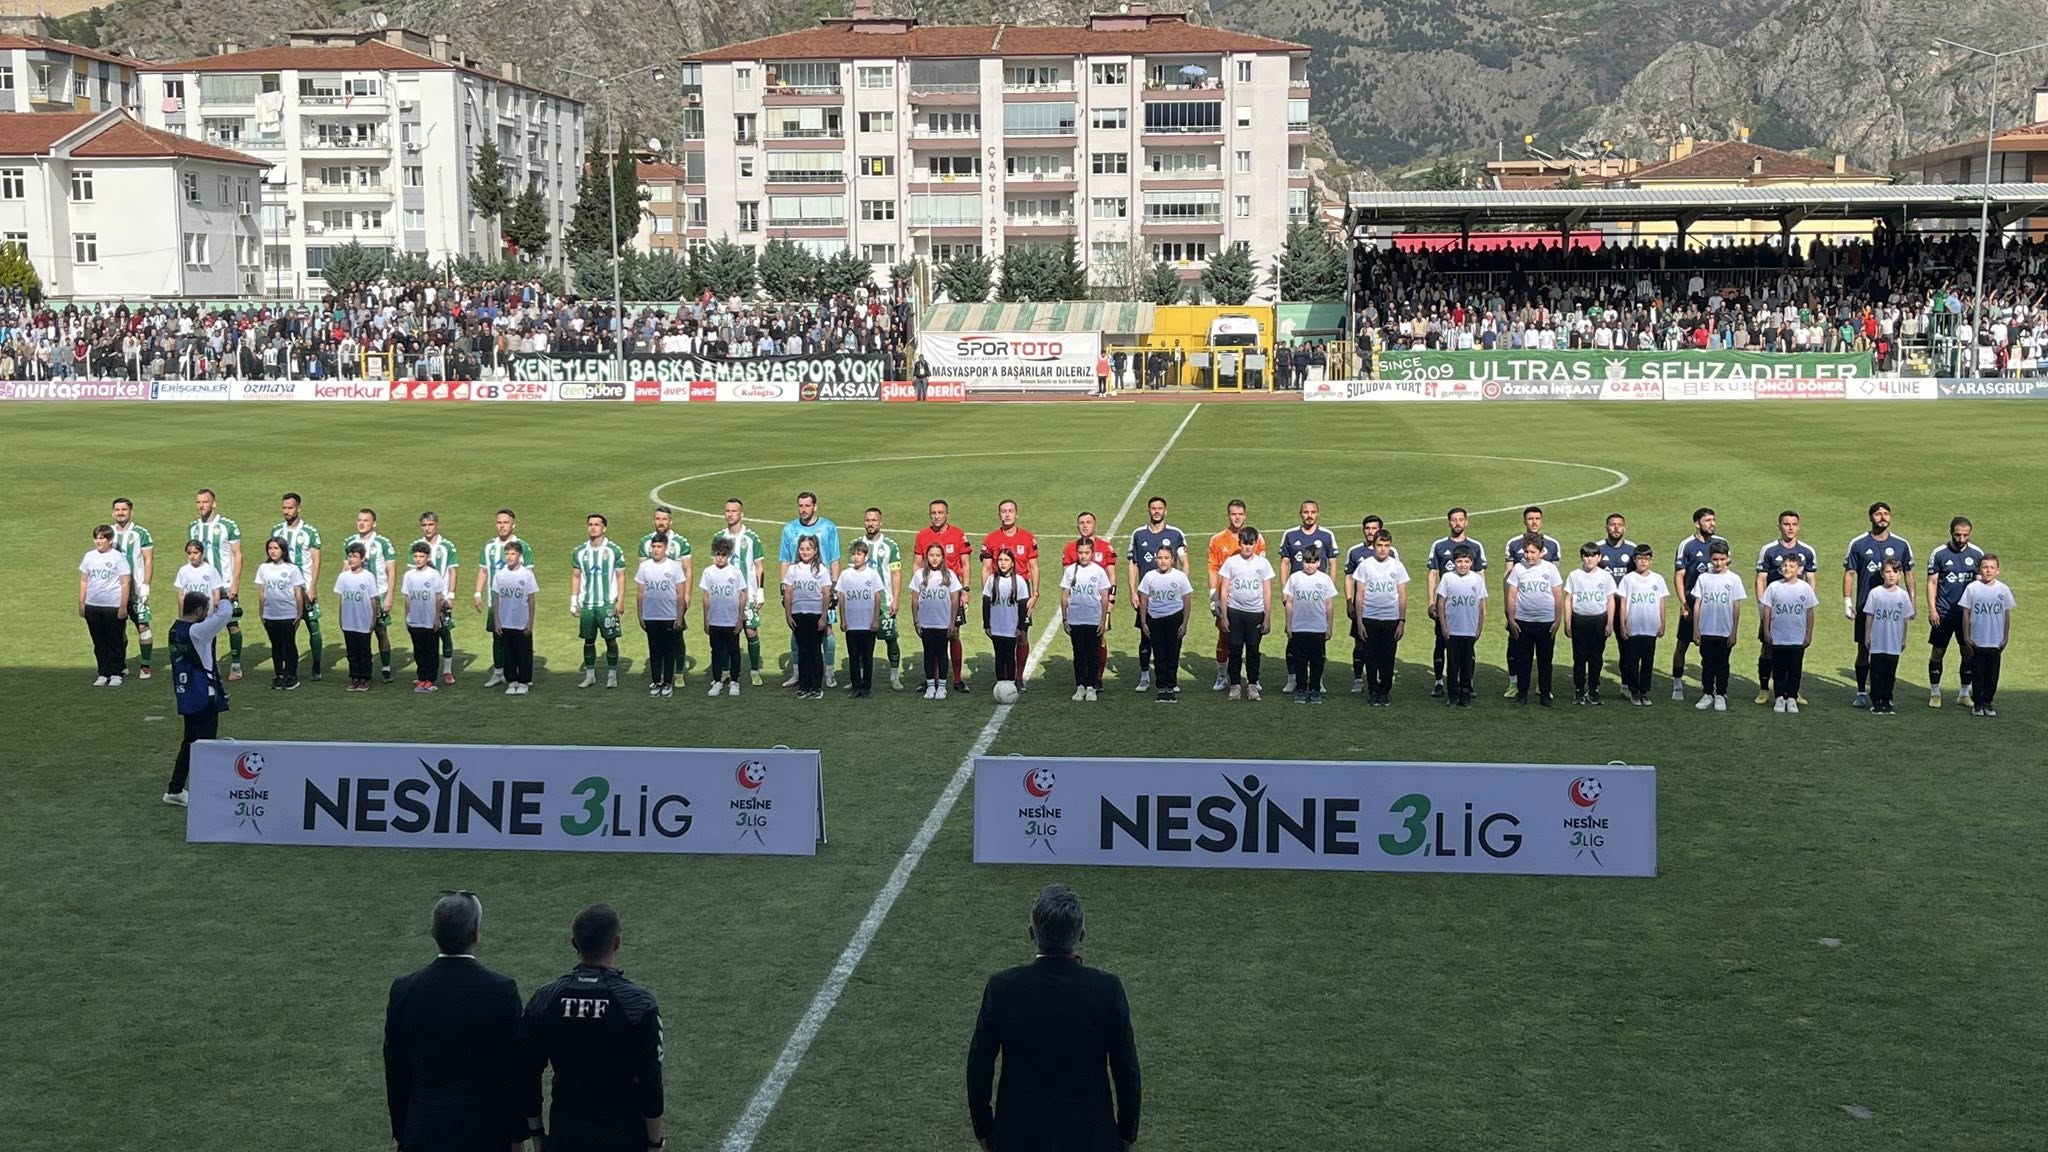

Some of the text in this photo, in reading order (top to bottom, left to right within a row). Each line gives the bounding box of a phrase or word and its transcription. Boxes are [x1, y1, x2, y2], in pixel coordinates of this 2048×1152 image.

[513, 354, 627, 382] KENETLENİ
[700, 359, 837, 383] AMASYASPOR
[838, 357, 886, 383] YOK!
[1379, 356, 1423, 372] SINCE
[1469, 360, 1592, 381] ULTRAS
[929, 366, 998, 378] MASYASPOR'A
[1001, 366, 1053, 380] BAŞARILAR
[1400, 363, 1454, 381] 2009
[315, 383, 384, 398] kentkur
[635, 387, 660, 397] aves
[663, 387, 687, 396] aves
[690, 387, 715, 397] aves
[820, 383, 880, 397] AKSAV
[882, 382, 966, 400] ŞÜKR DERİCİ
[1394, 382, 1422, 394] YURT
[1424, 383, 1439, 398] ET
[1502, 381, 1600, 397] ÖZKAR İNŞAAT
[1632, 382, 1660, 392] ATA
[881, 618, 893, 630] 27
[560, 998, 610, 1019] TFF
